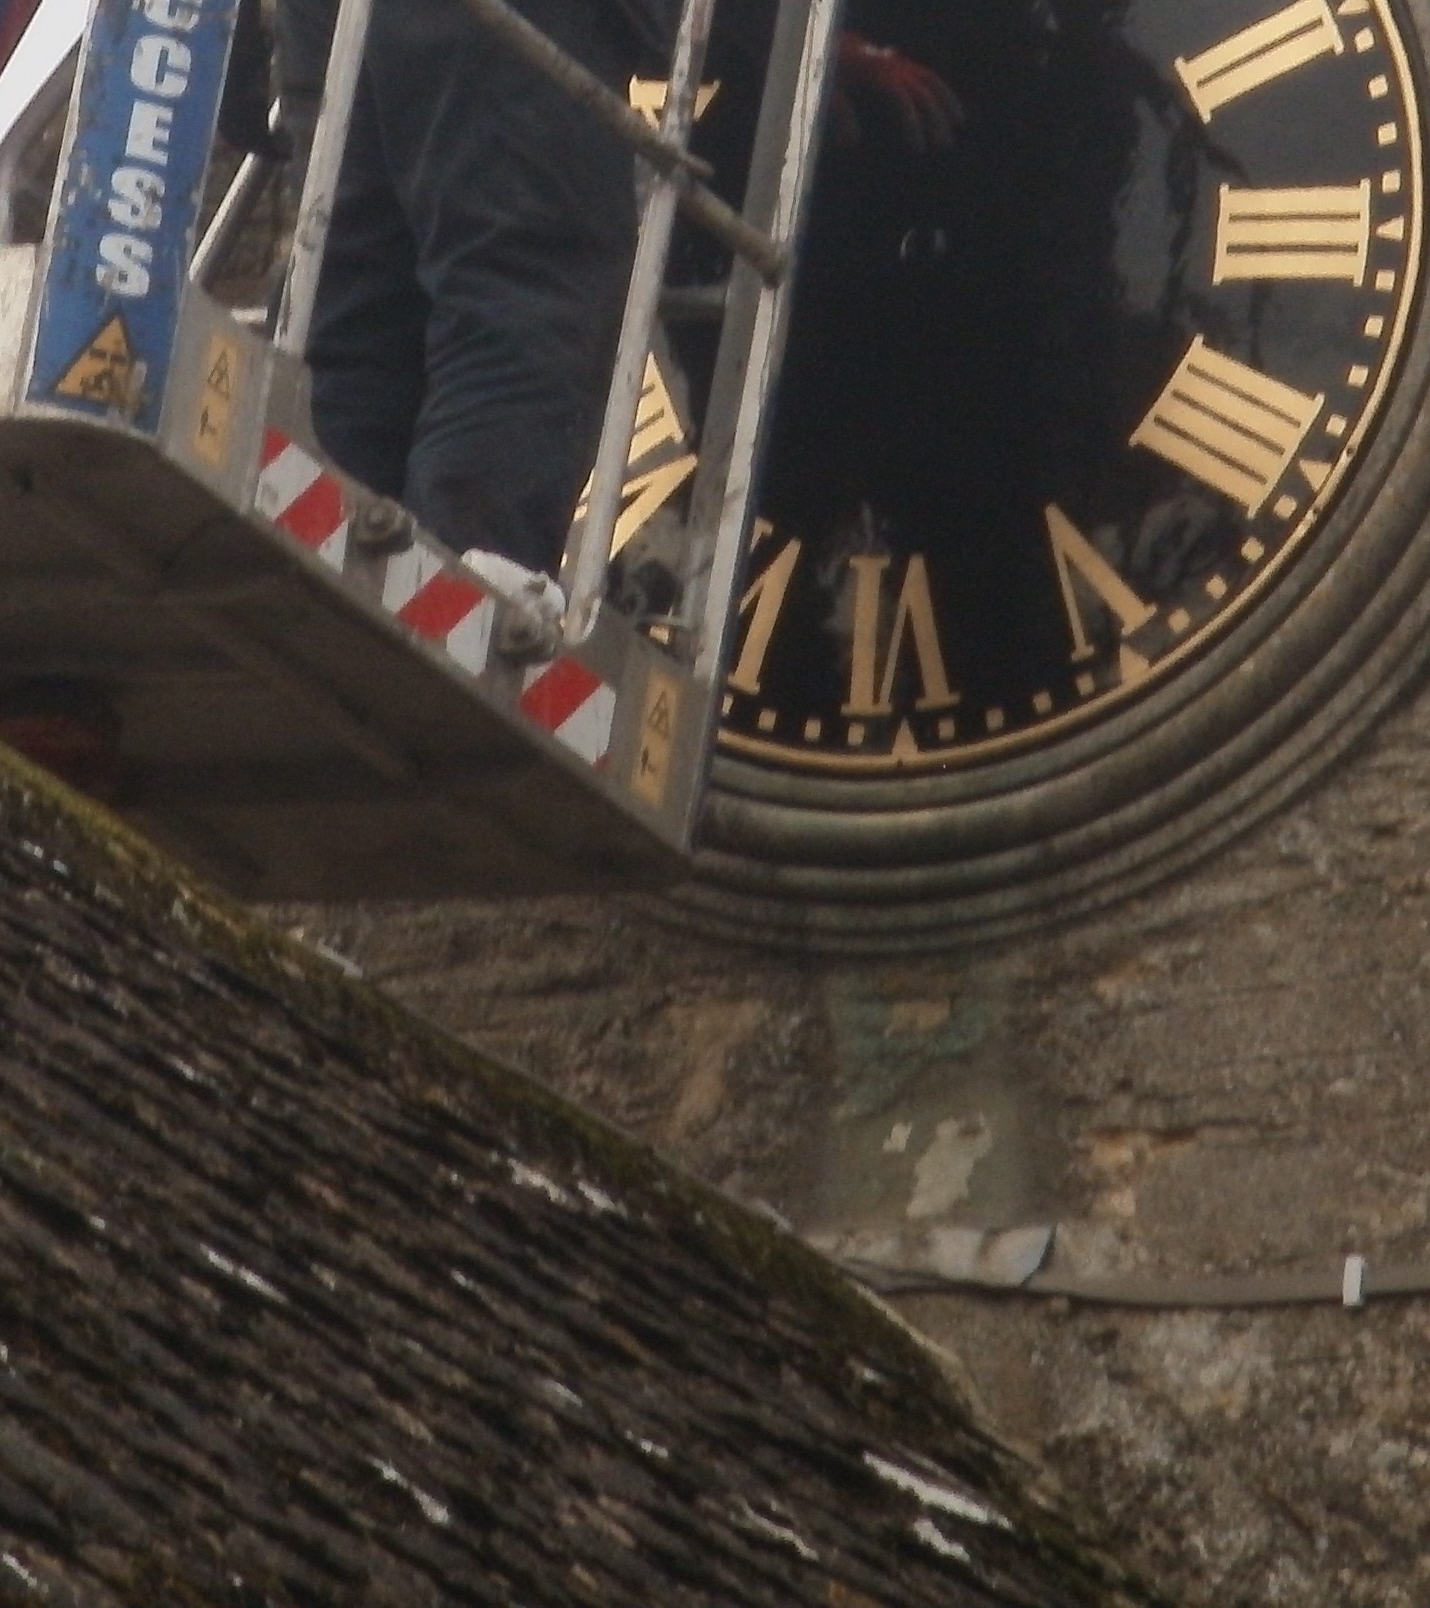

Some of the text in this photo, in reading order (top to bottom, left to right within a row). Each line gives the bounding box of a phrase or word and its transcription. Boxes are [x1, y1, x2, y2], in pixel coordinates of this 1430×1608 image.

[1213, 180, 1370, 286] III
[1128, 335, 1325, 519] IIII
[841, 554, 961, 717] VI
[1045, 502, 1157, 661] V
